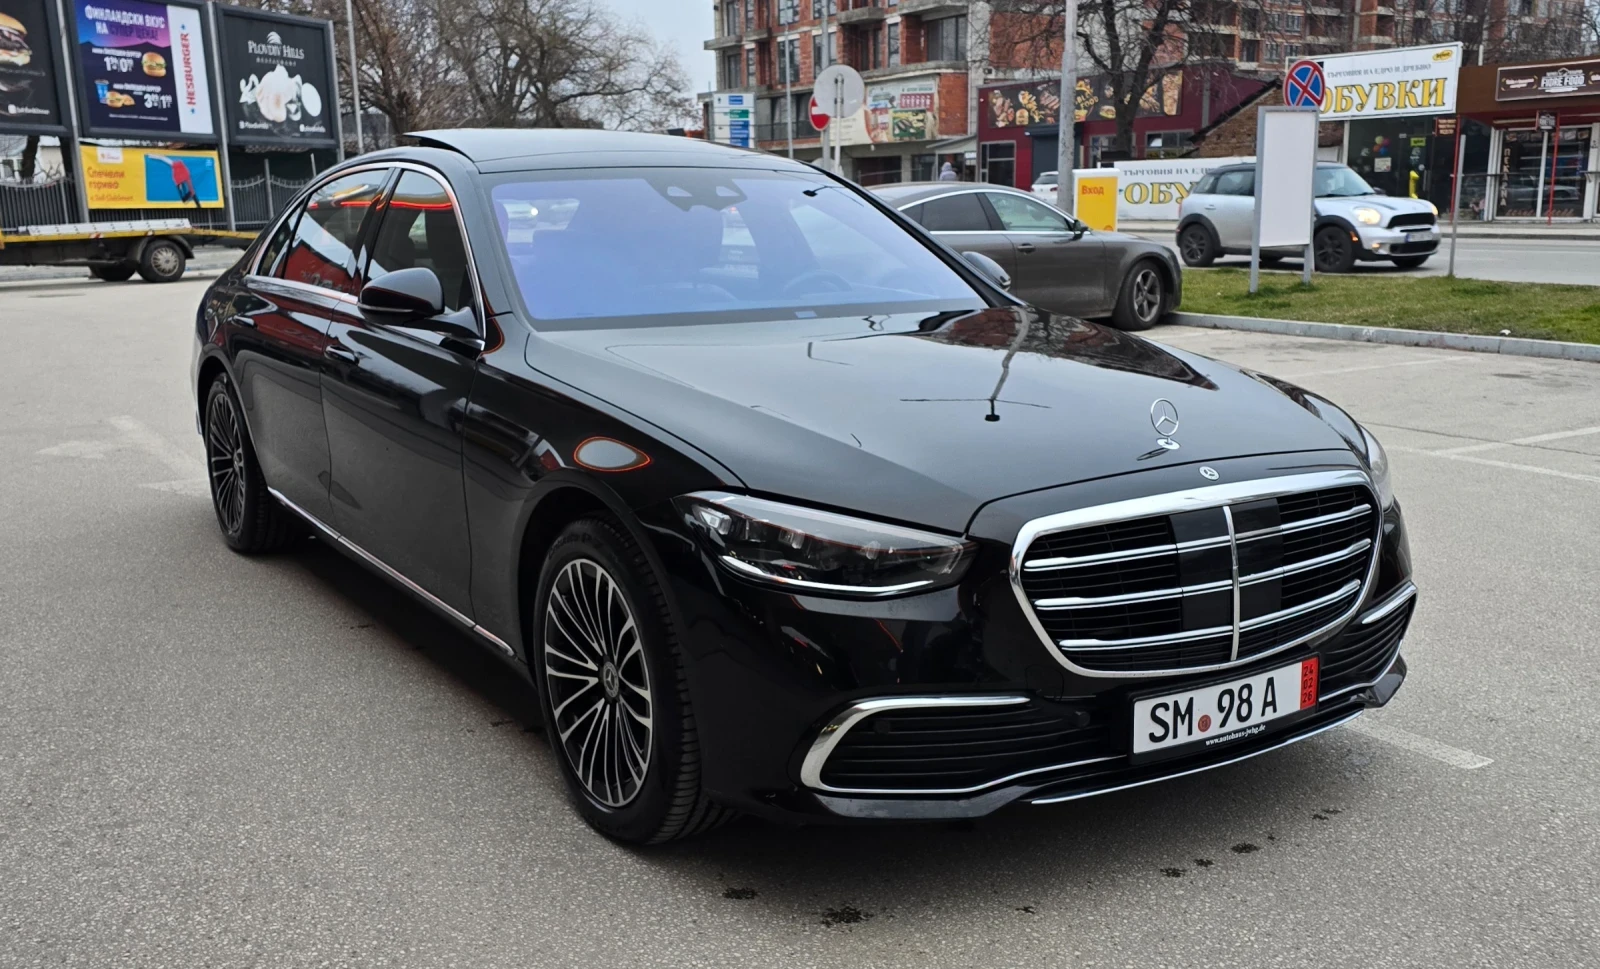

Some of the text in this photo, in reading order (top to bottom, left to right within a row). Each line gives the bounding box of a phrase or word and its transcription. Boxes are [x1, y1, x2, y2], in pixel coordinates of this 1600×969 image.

[84, 4, 165, 28] ФИНЛАНДСКИ ВКУС
[95, 21, 109, 35] НА
[282, 44, 305, 60] HILLS
[180, 32, 196, 106] HESBURGER
[1176, 167, 1189, 175] НА
[1081, 185, 1104, 196] Вход
[1124, 181, 1198, 205] ОБУ
[1303, 664, 1314, 677] 24
[1303, 677, 1314, 690] 02
[1302, 691, 1312, 703] 26
[1149, 676, 1277, 743] SM 98 A
